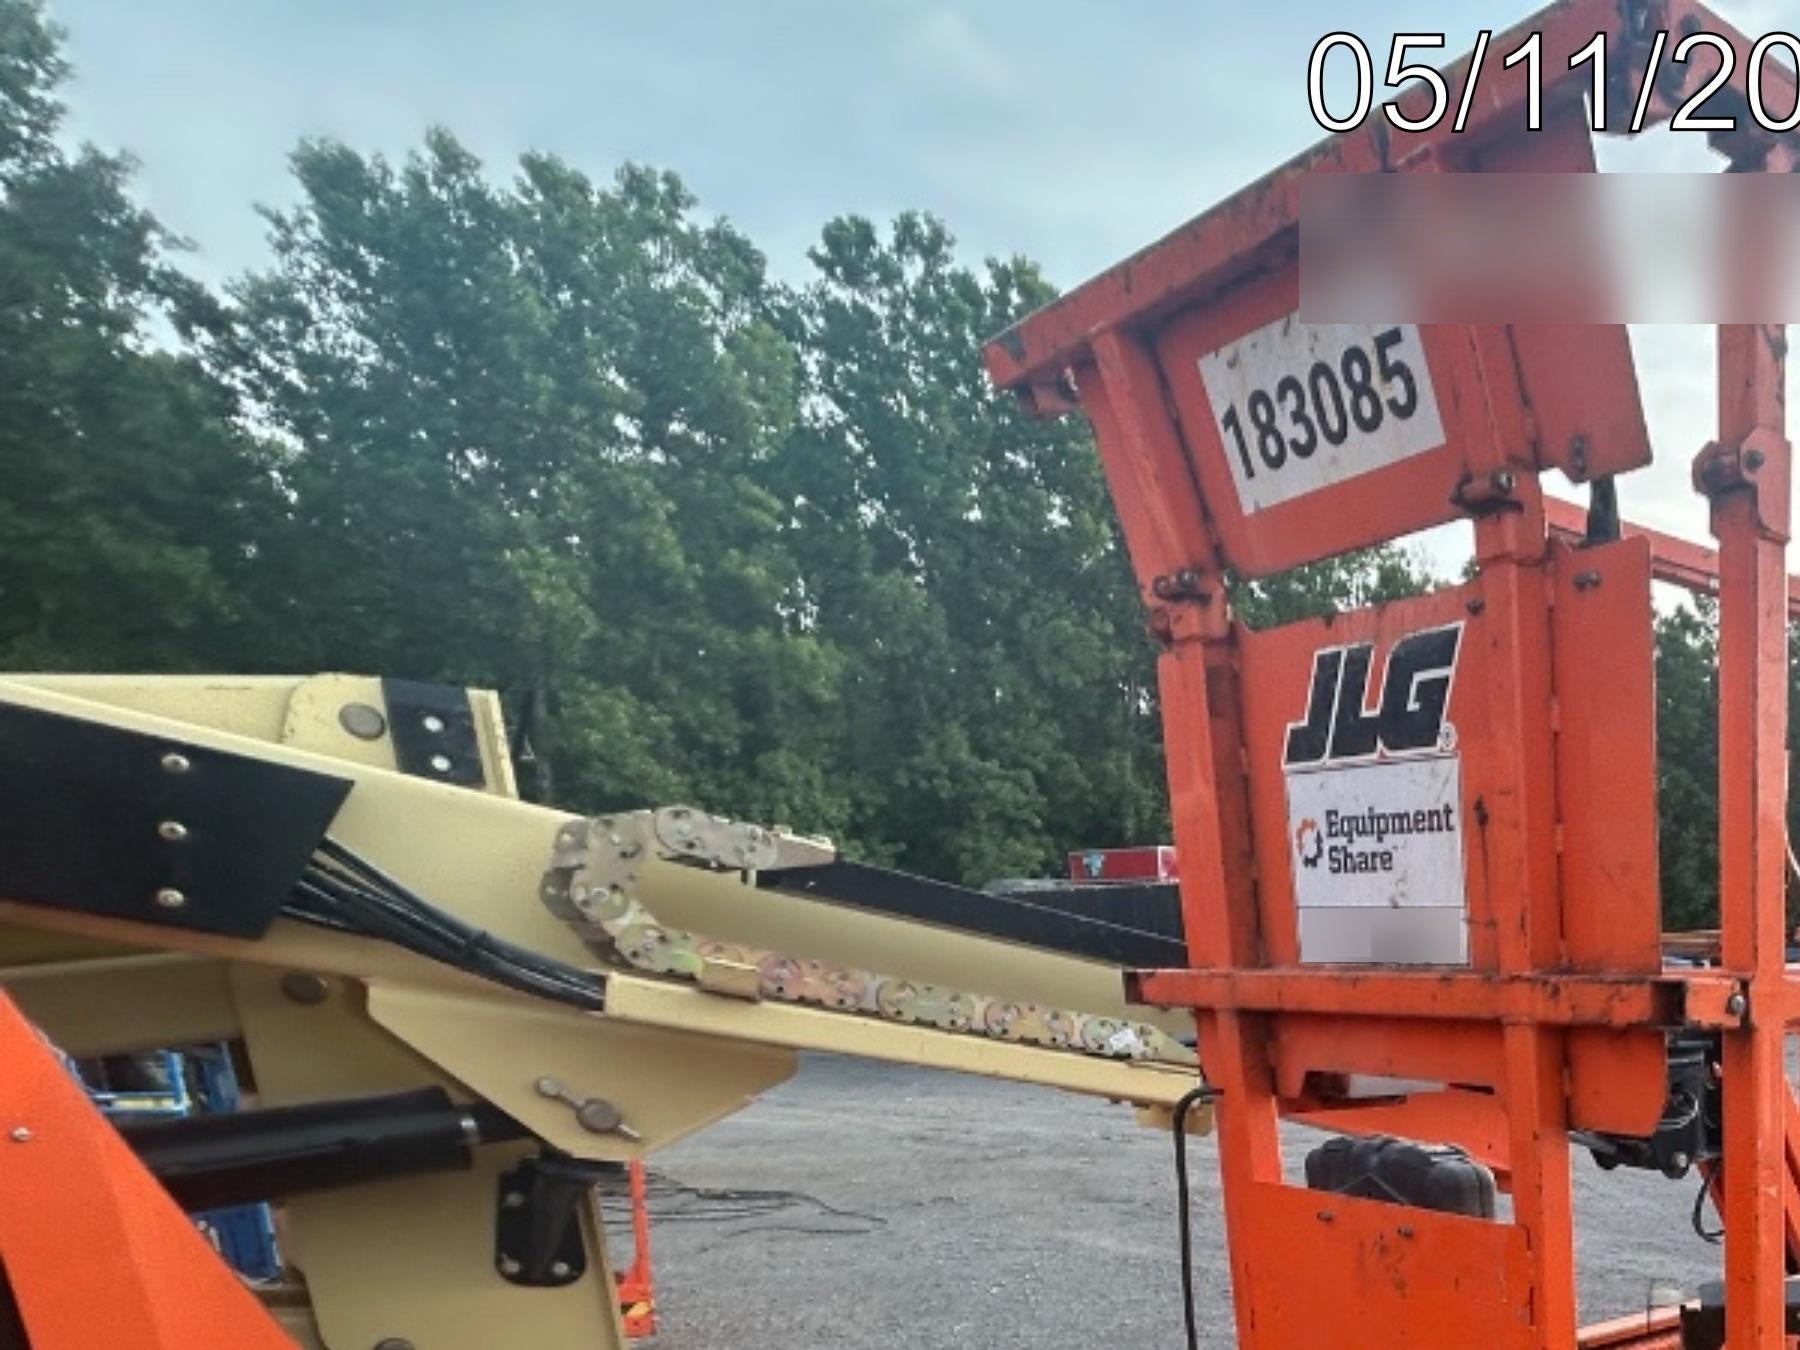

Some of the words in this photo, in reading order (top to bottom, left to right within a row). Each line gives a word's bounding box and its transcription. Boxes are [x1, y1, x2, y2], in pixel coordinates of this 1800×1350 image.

[1221, 328, 1419, 482] 183085
[1284, 622, 1465, 769] JLG
[1326, 803, 1454, 843] Equipment
[1328, 845, 1393, 874] Share
